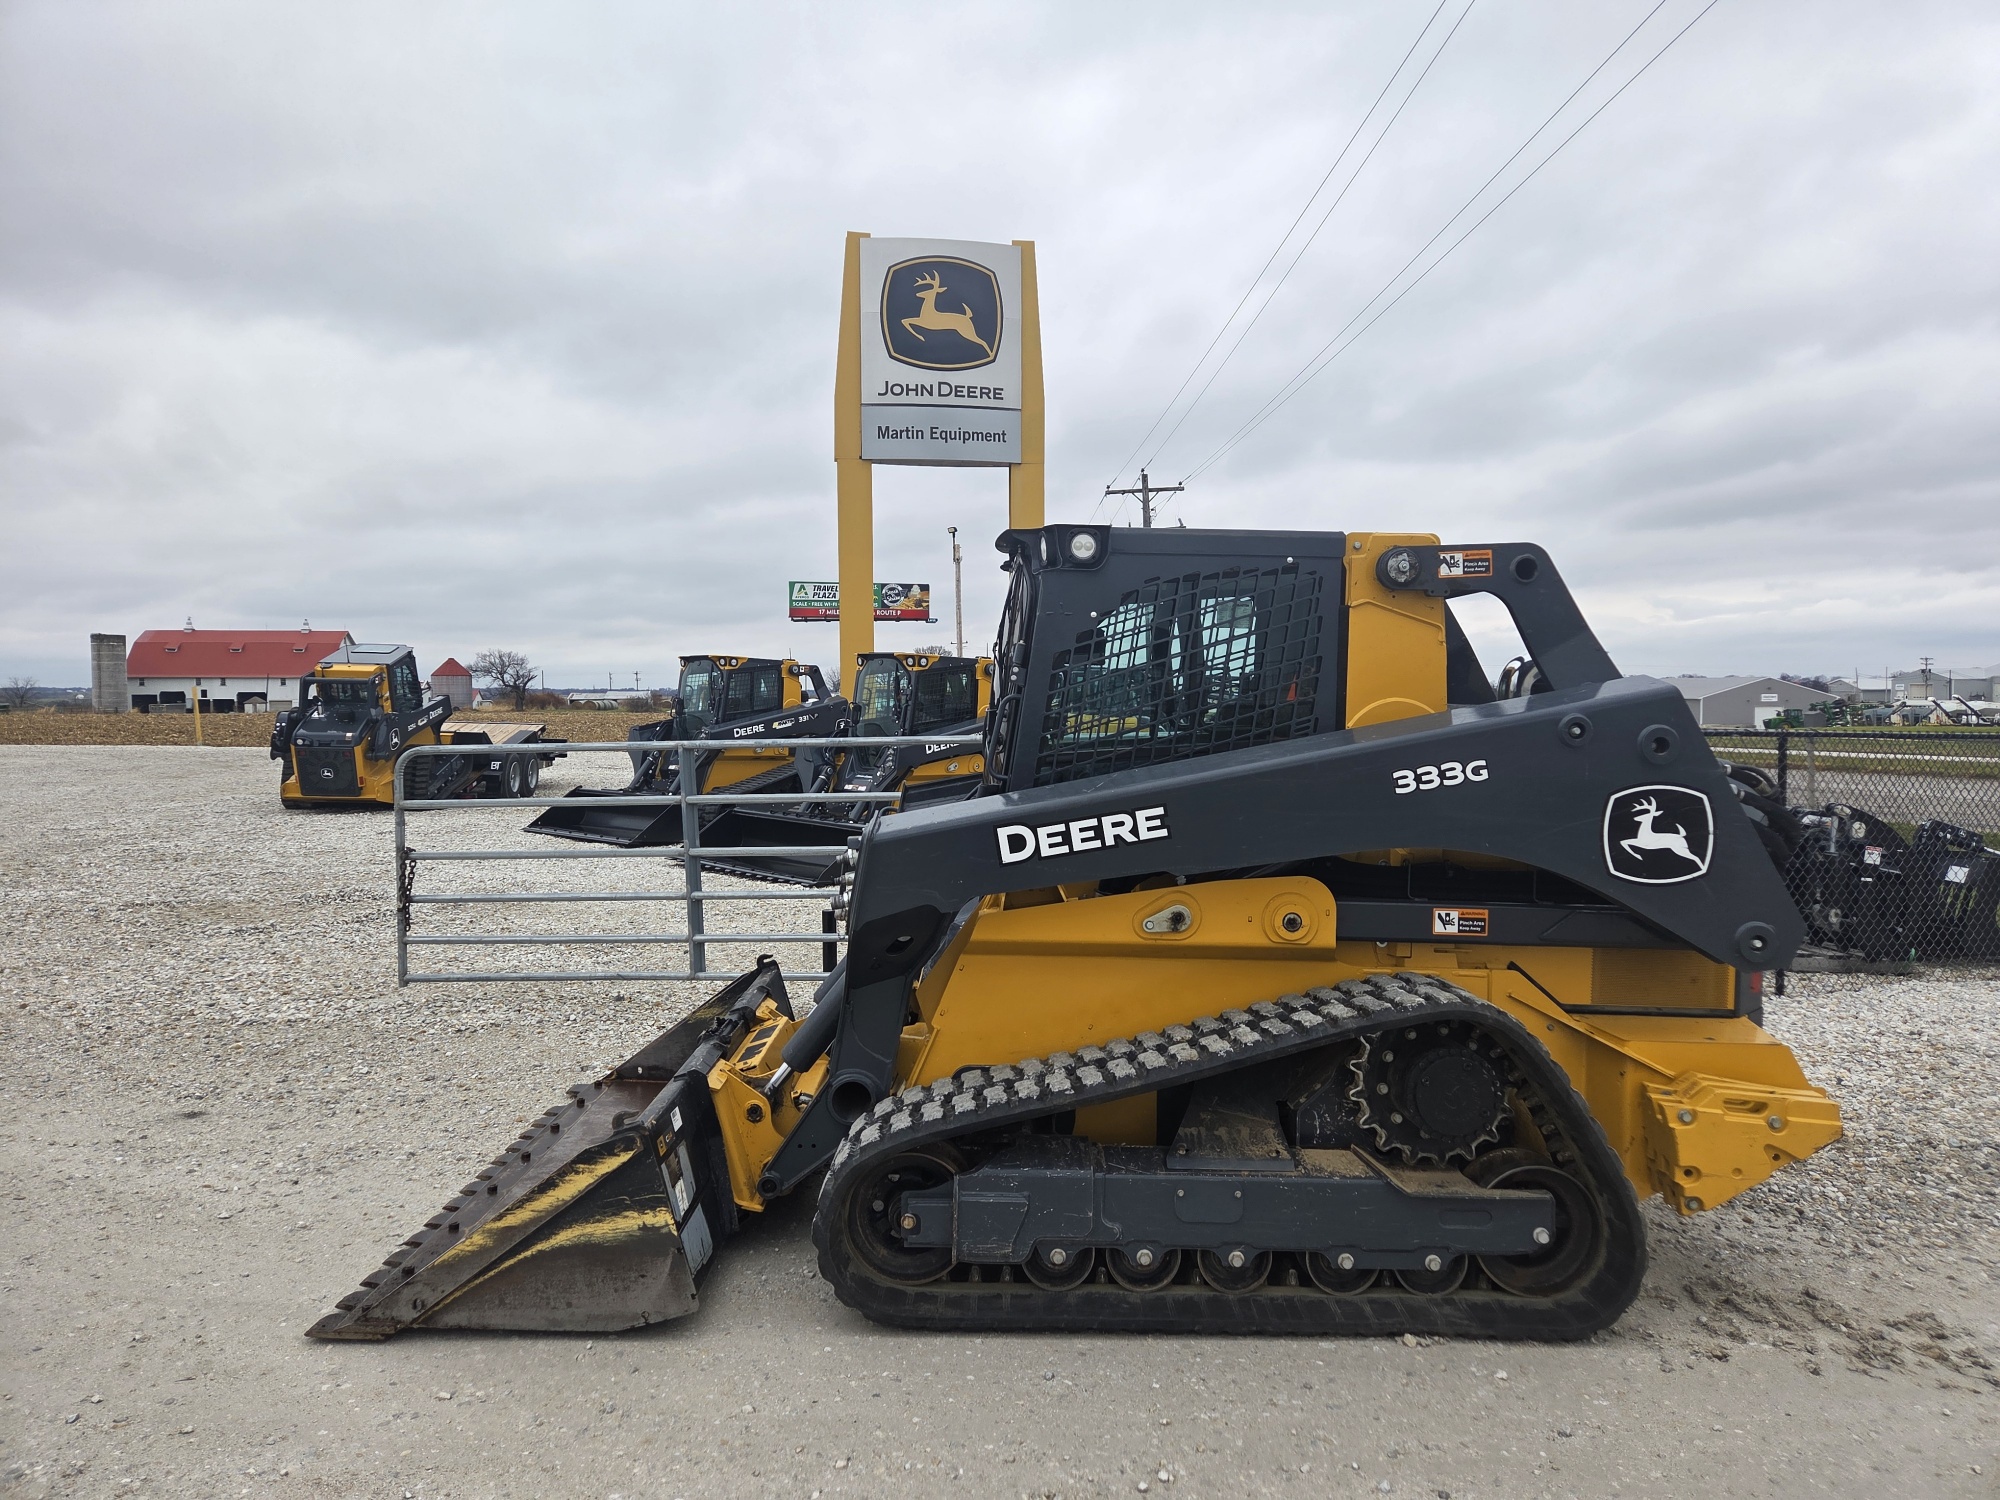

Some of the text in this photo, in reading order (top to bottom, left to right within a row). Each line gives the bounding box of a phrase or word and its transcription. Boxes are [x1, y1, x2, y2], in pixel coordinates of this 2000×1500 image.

[877, 380, 1005, 401] JOHN DEERE
[877, 425, 1007, 444] Martin Equipment
[733, 724, 766, 738] DEERE
[798, 715, 809, 723] 331
[925, 743, 960, 755] DEE
[1392, 759, 1489, 794] 333G
[997, 806, 1169, 864] DEERE
